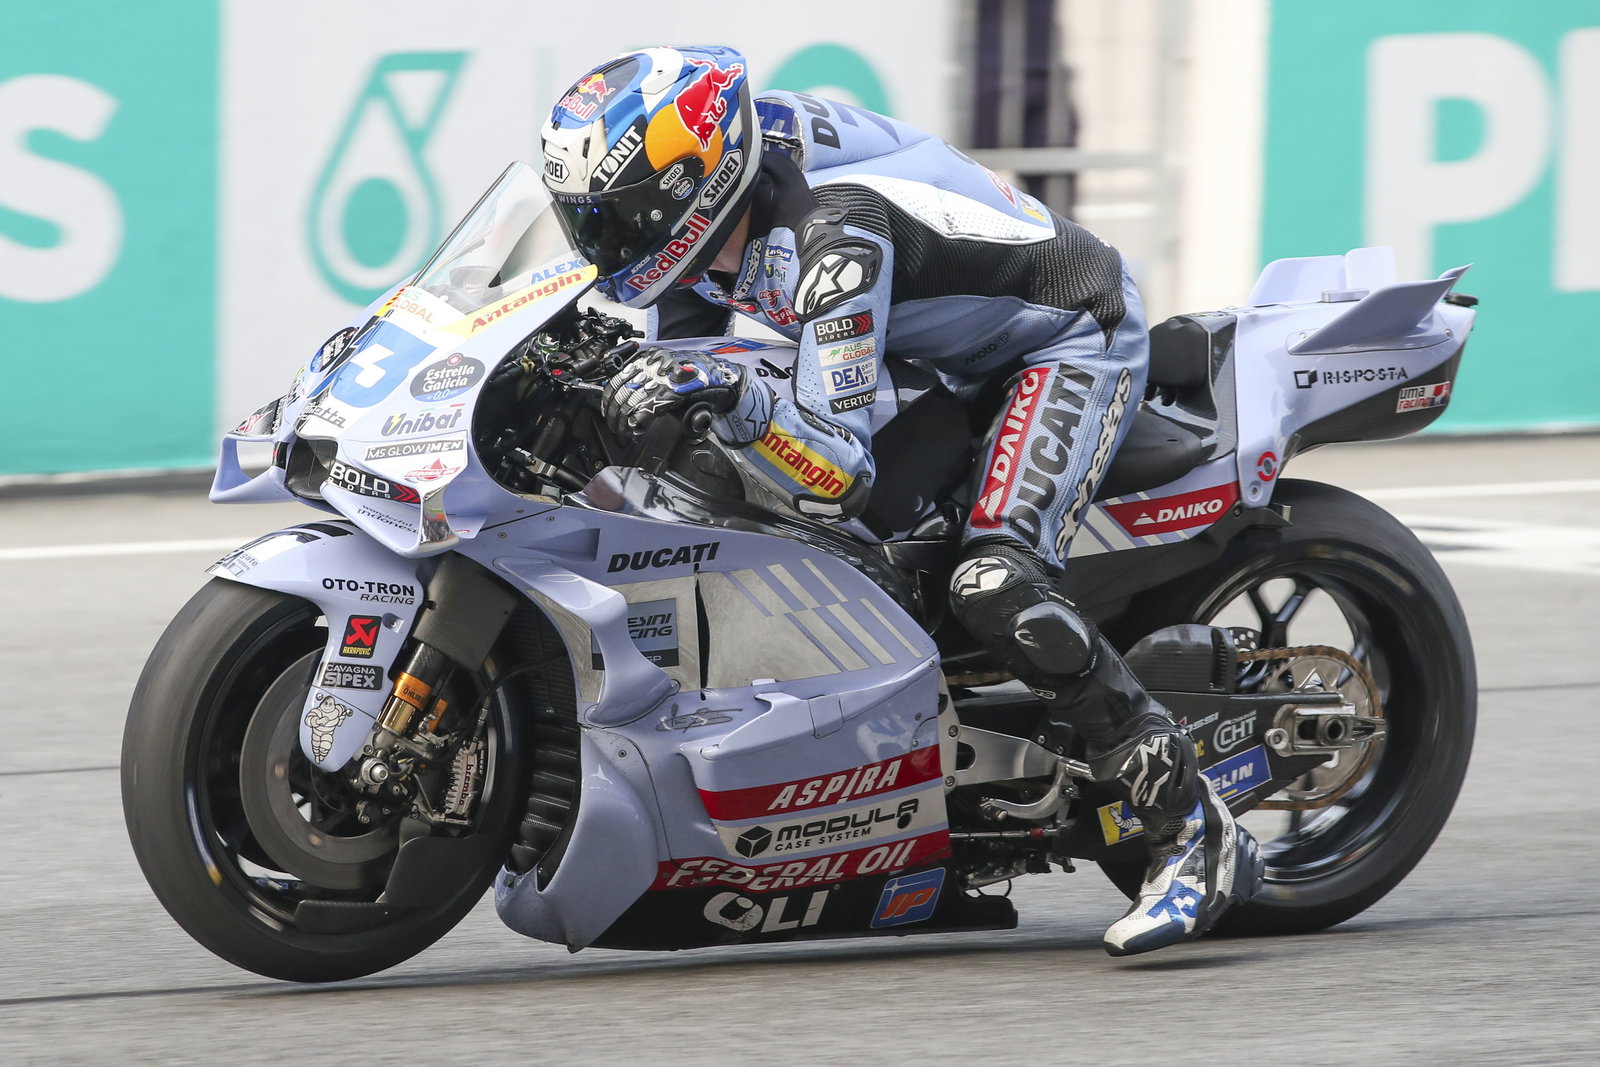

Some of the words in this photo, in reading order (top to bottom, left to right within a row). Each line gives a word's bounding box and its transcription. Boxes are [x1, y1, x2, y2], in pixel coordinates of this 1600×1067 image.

[570, 92, 598, 120] Bull
[544, 158, 563, 180] HOEI
[1364, 28, 1600, 292] P
[663, 167, 682, 187] SHOEI
[704, 157, 740, 204] SHOEI
[558, 195, 592, 204] WINGS
[626, 251, 671, 291] Red
[663, 213, 711, 259] Bull
[530, 257, 583, 285] ALEX
[471, 271, 582, 332] Antangin
[816, 318, 853, 336] BOLD
[818, 330, 855, 342] RIDERS
[842, 347, 875, 360] GLOBAL
[422, 376, 468, 392] Galicia
[424, 365, 475, 381] Estrella
[831, 366, 867, 388] DEA
[1400, 387, 1425, 399] uma
[381, 409, 463, 437] Unibat
[998, 371, 1040, 484] DAIKO
[367, 446, 385, 459] MS
[387, 443, 425, 457] GLOW
[760, 426, 844, 496] ntangin
[1009, 363, 1096, 548] DUCATI
[330, 462, 389, 493] BOLD
[1156, 498, 1223, 523] DAIKO
[607, 541, 720, 573] DUCATI
[322, 578, 415, 597] OTO-TRON
[360, 594, 415, 605] RACING
[628, 613, 672, 627] ESINI
[324, 672, 376, 688] SIPEX
[326, 664, 376, 675] CAVAGNA
[1221, 716, 1256, 746] CHT
[459, 763, 474, 806] brembo
[767, 759, 902, 811] ASPIRA
[1211, 763, 1254, 793] ELIN
[776, 798, 919, 842] MODULA
[775, 837, 811, 852] CASE
[818, 827, 871, 847] SYSTEM
[666, 853, 848, 891] FEDERAL
[703, 890, 830, 933] OLI
